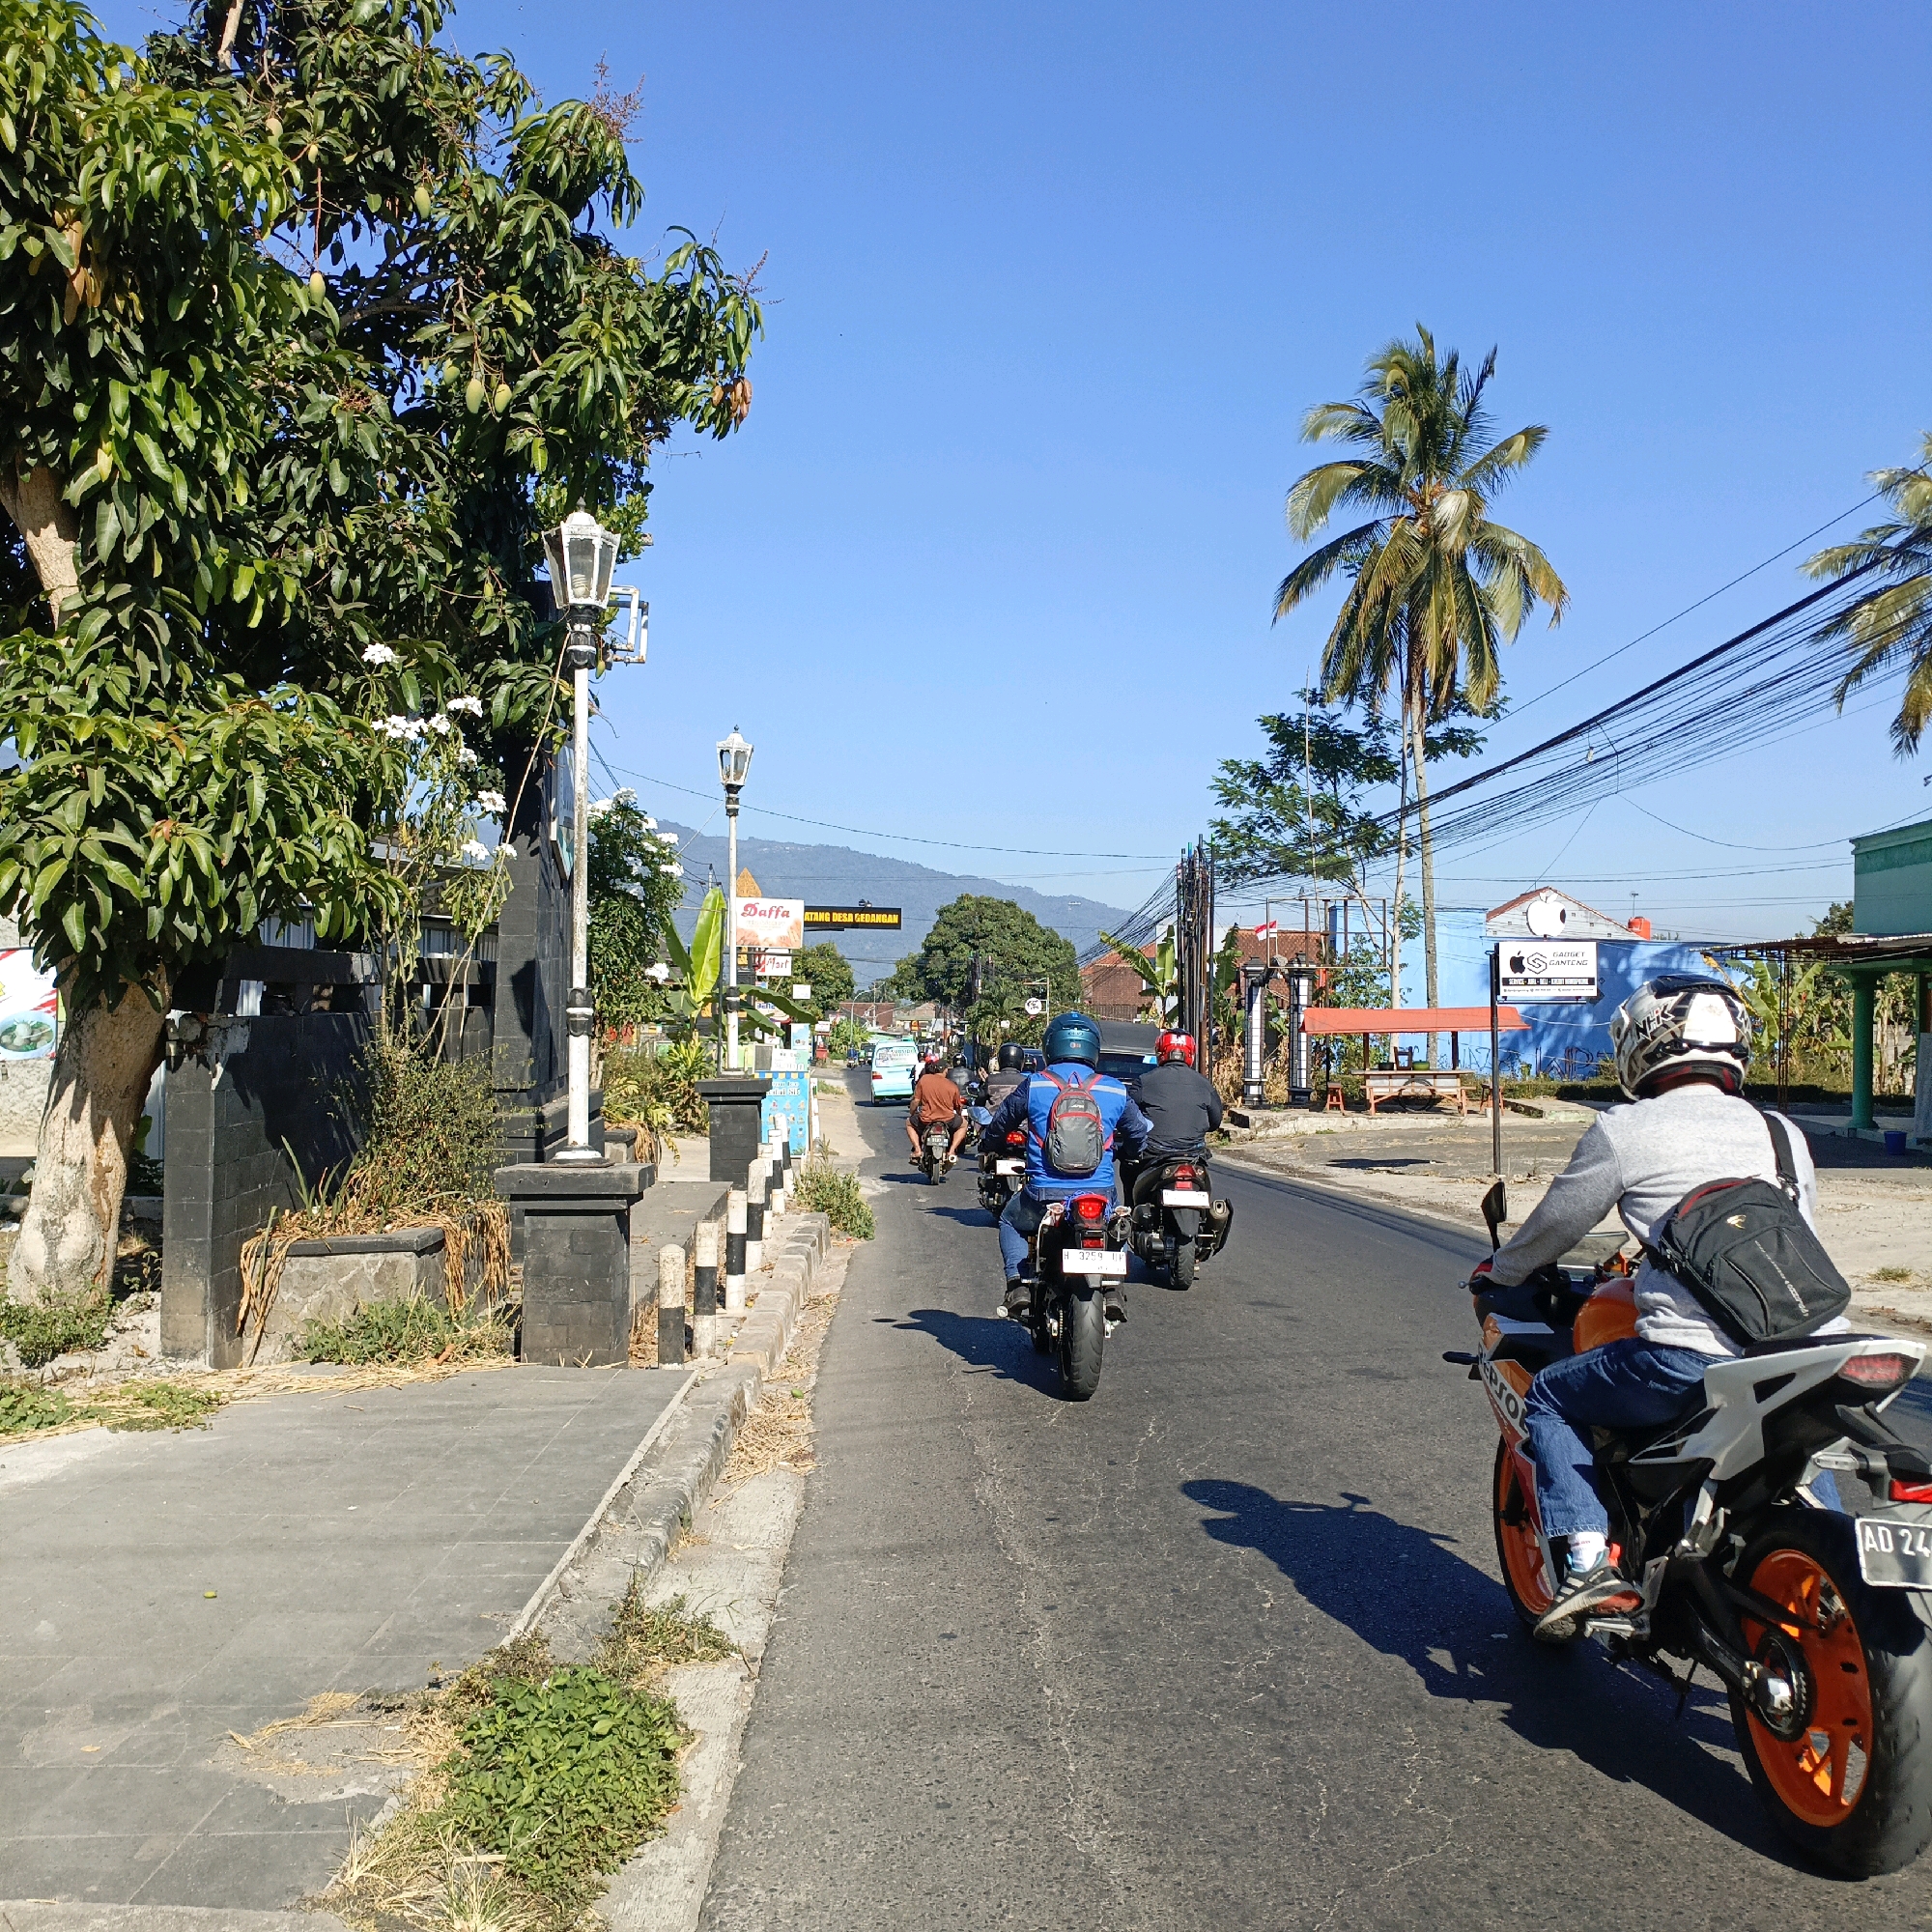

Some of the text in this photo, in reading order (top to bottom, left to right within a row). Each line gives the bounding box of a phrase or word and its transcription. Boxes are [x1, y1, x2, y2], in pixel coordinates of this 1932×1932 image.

[741, 902, 790, 919] Daffa
[804, 912, 898, 923] ATANG DESA GEDANGAN
[766, 957, 789, 970] Mart
[1635, 1003, 1675, 1041] NHK
[1064, 1251, 1069, 1260] H
[1079, 1251, 1103, 1261] 3259
[1865, 1525, 1894, 1553] AD
